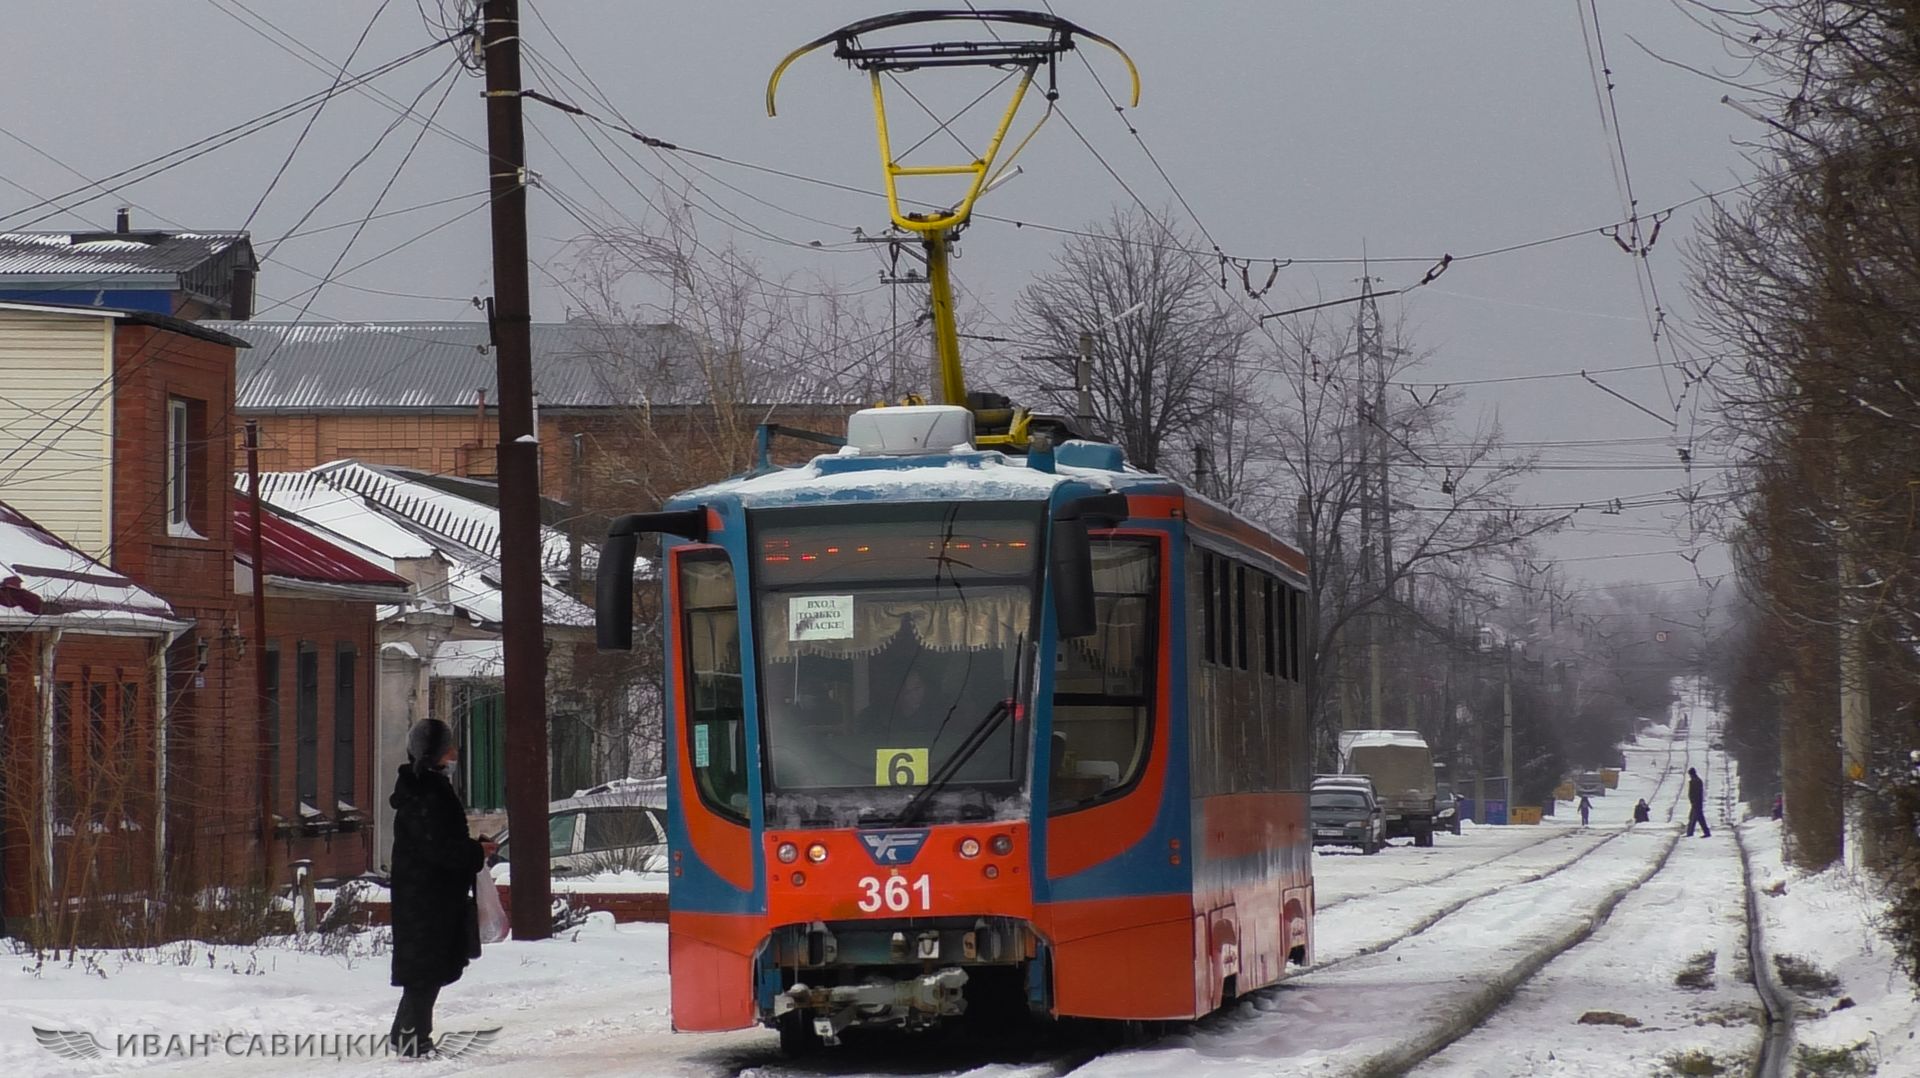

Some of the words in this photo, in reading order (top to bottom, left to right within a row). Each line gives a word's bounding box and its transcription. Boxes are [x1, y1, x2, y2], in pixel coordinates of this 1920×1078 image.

[797, 610, 841, 619] ТОЛЬКО
[807, 600, 835, 609] ВХОД
[888, 752, 914, 786] 6
[858, 874, 931, 912] 361
